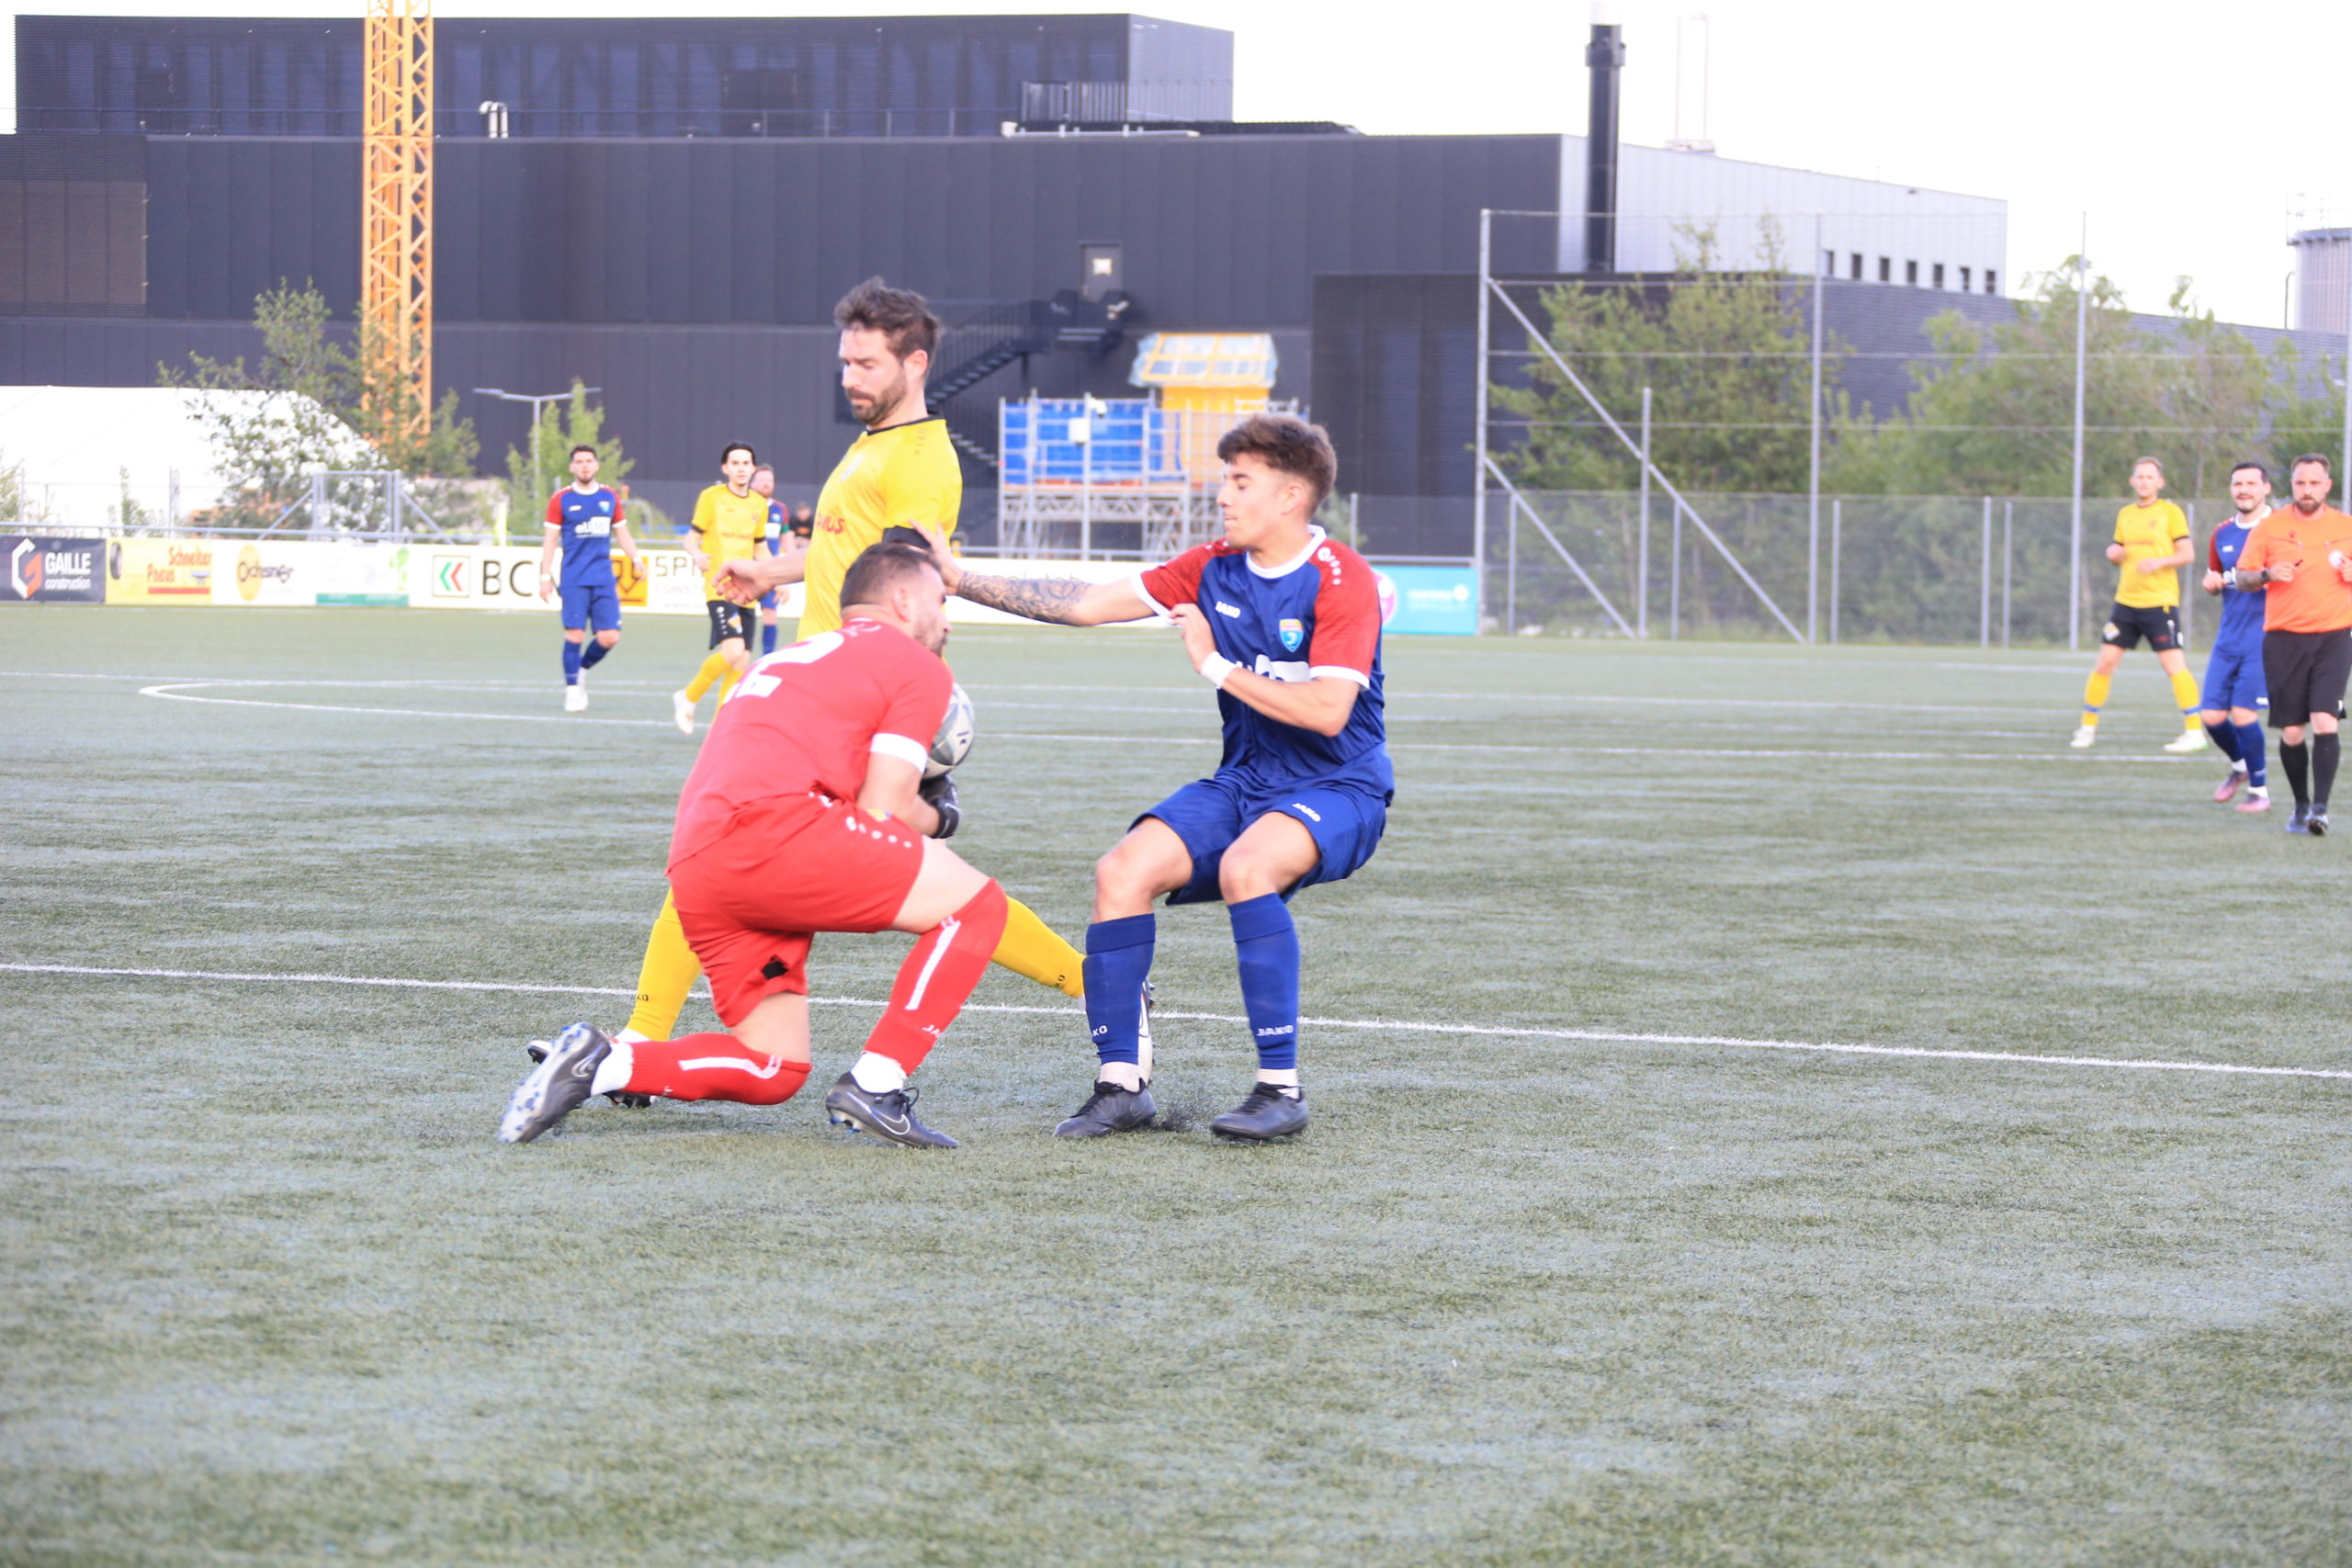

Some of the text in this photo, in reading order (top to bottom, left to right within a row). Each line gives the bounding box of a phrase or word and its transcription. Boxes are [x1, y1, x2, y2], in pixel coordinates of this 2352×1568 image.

[45, 552, 91, 575] GAILLE
[45, 577, 91, 591] construction
[722, 630, 844, 704] 2
[1091, 1025, 1108, 1037] KO
[1256, 1024, 1294, 1037] JAKO
